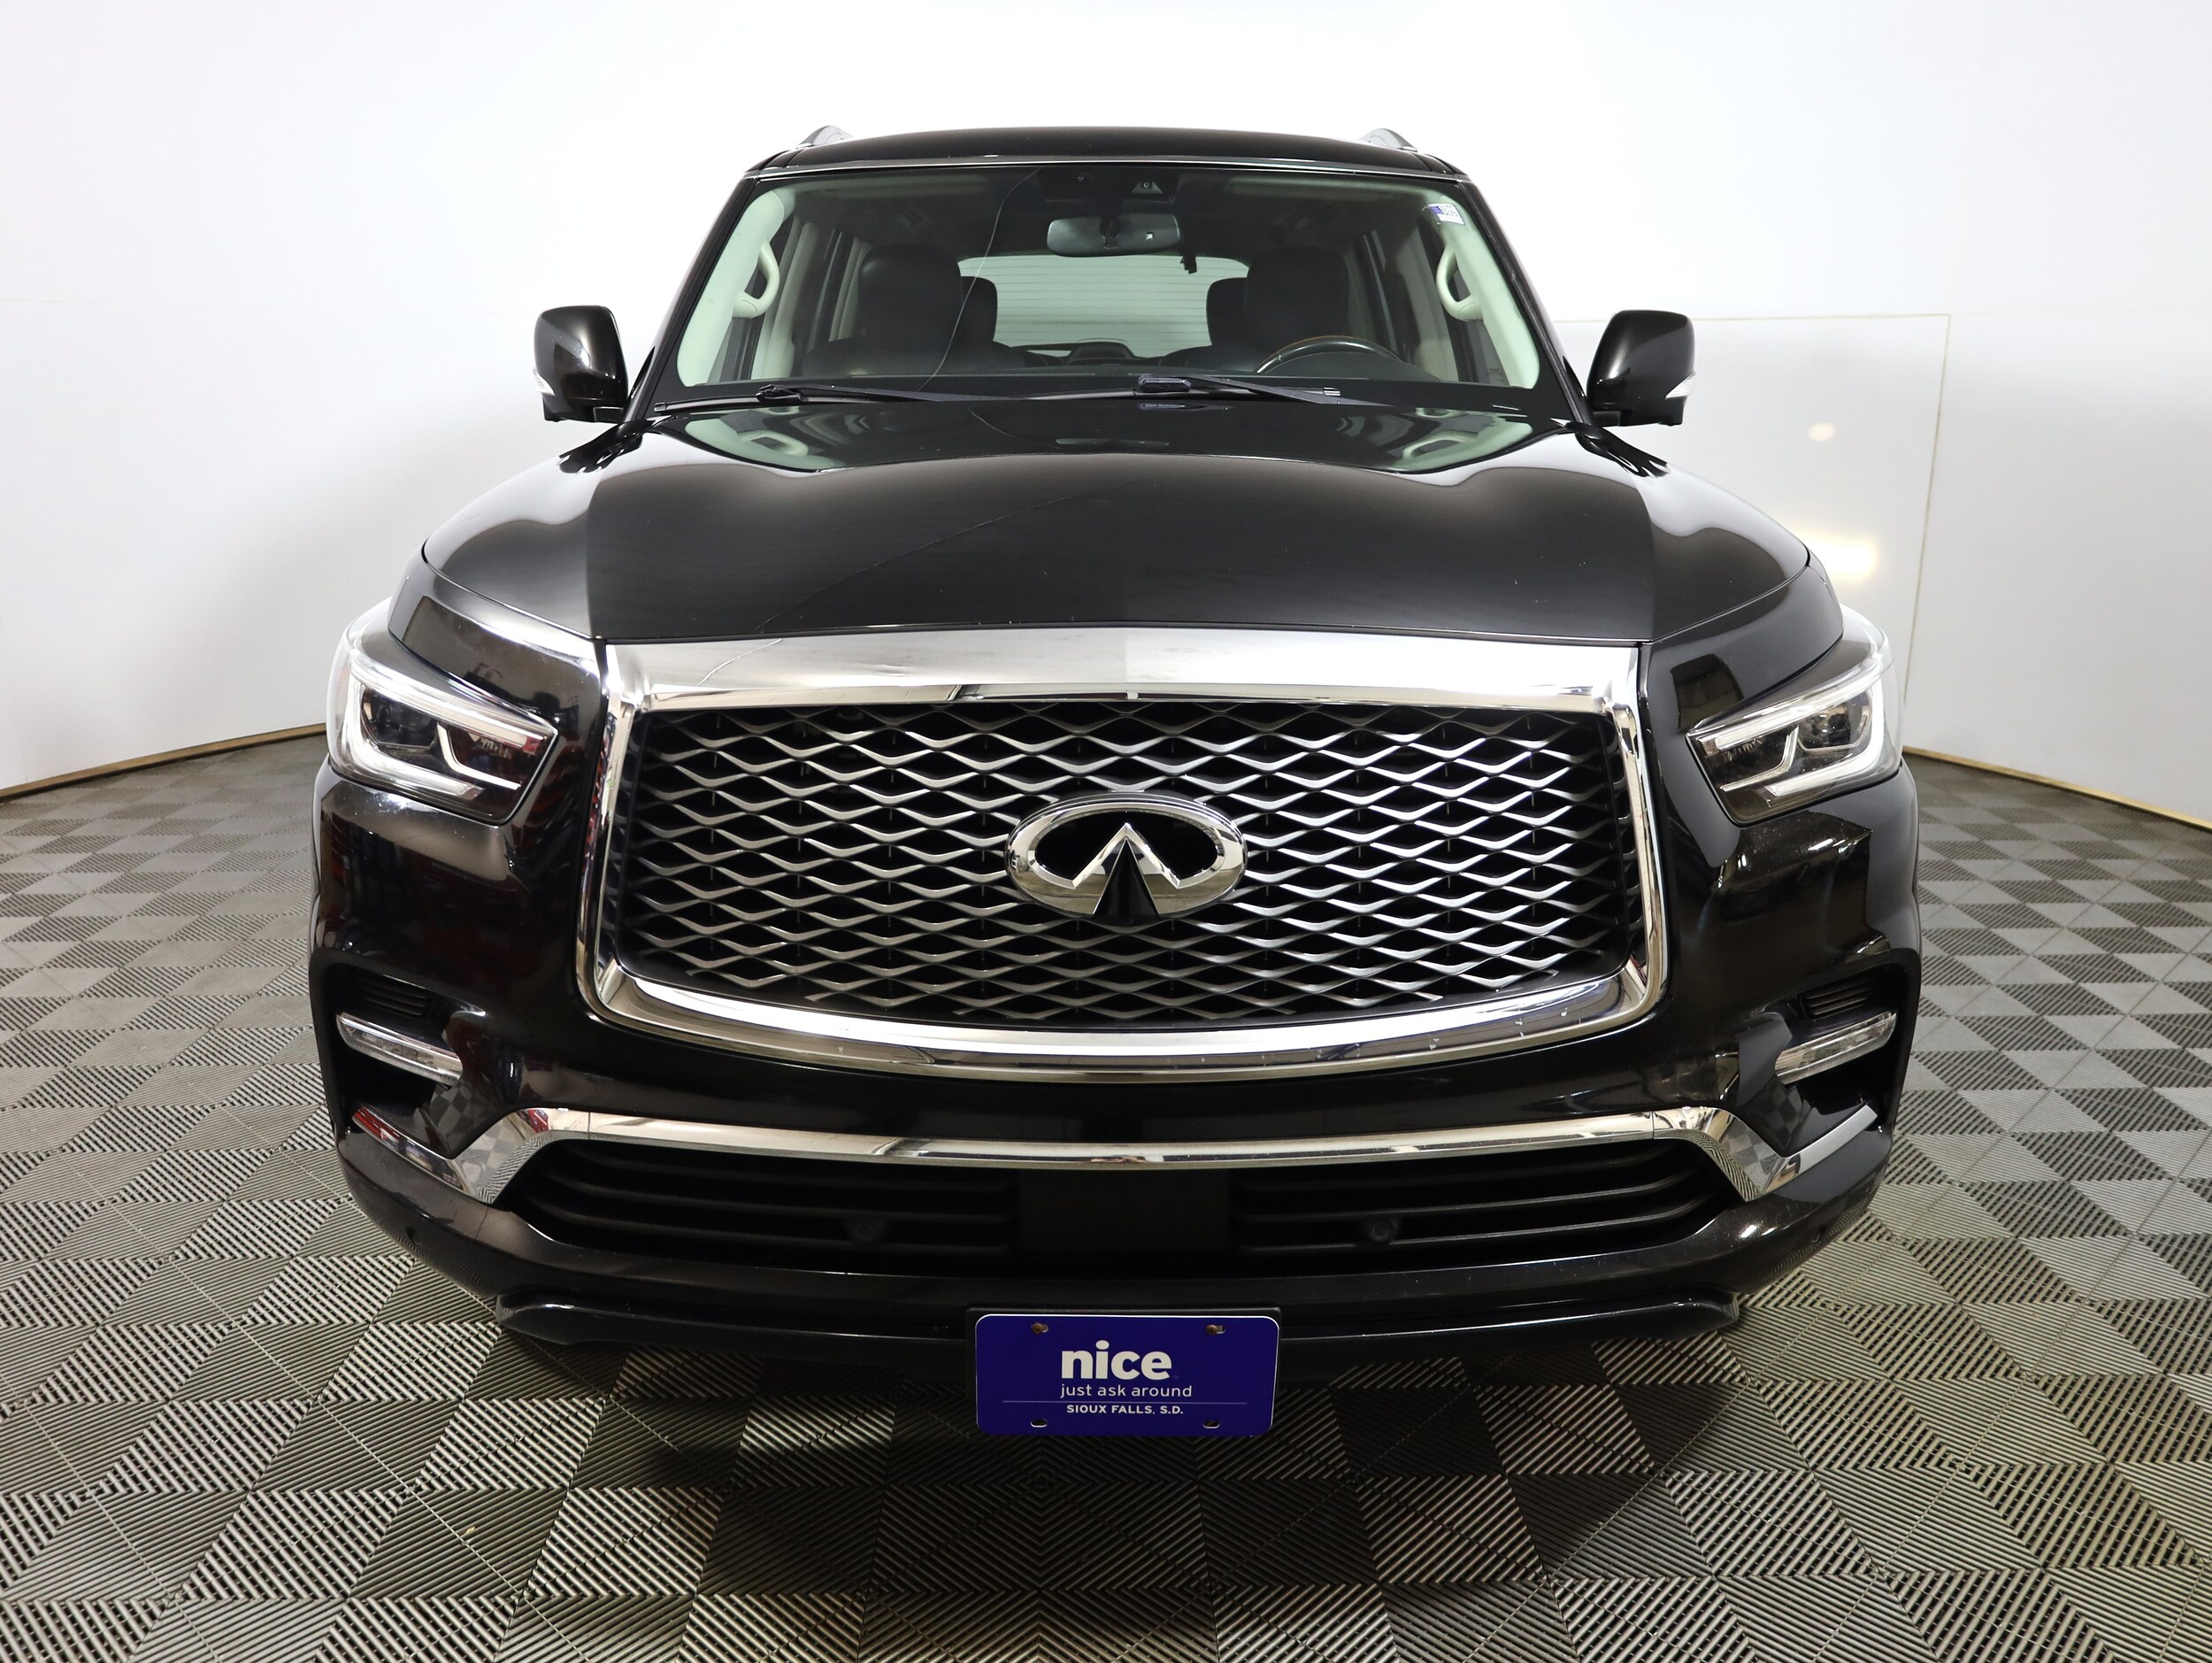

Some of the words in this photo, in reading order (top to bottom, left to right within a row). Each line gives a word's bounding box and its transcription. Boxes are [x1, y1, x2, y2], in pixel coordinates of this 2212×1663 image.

[1061, 1339, 1172, 1381] nice
[1060, 1383, 1093, 1398] just
[1097, 1384, 1126, 1397] ask
[1131, 1384, 1193, 1397] around
[1066, 1404, 1107, 1414] SIOUX
[1111, 1405, 1156, 1415] FALLS,
[1159, 1405, 1184, 1414] S.D.
